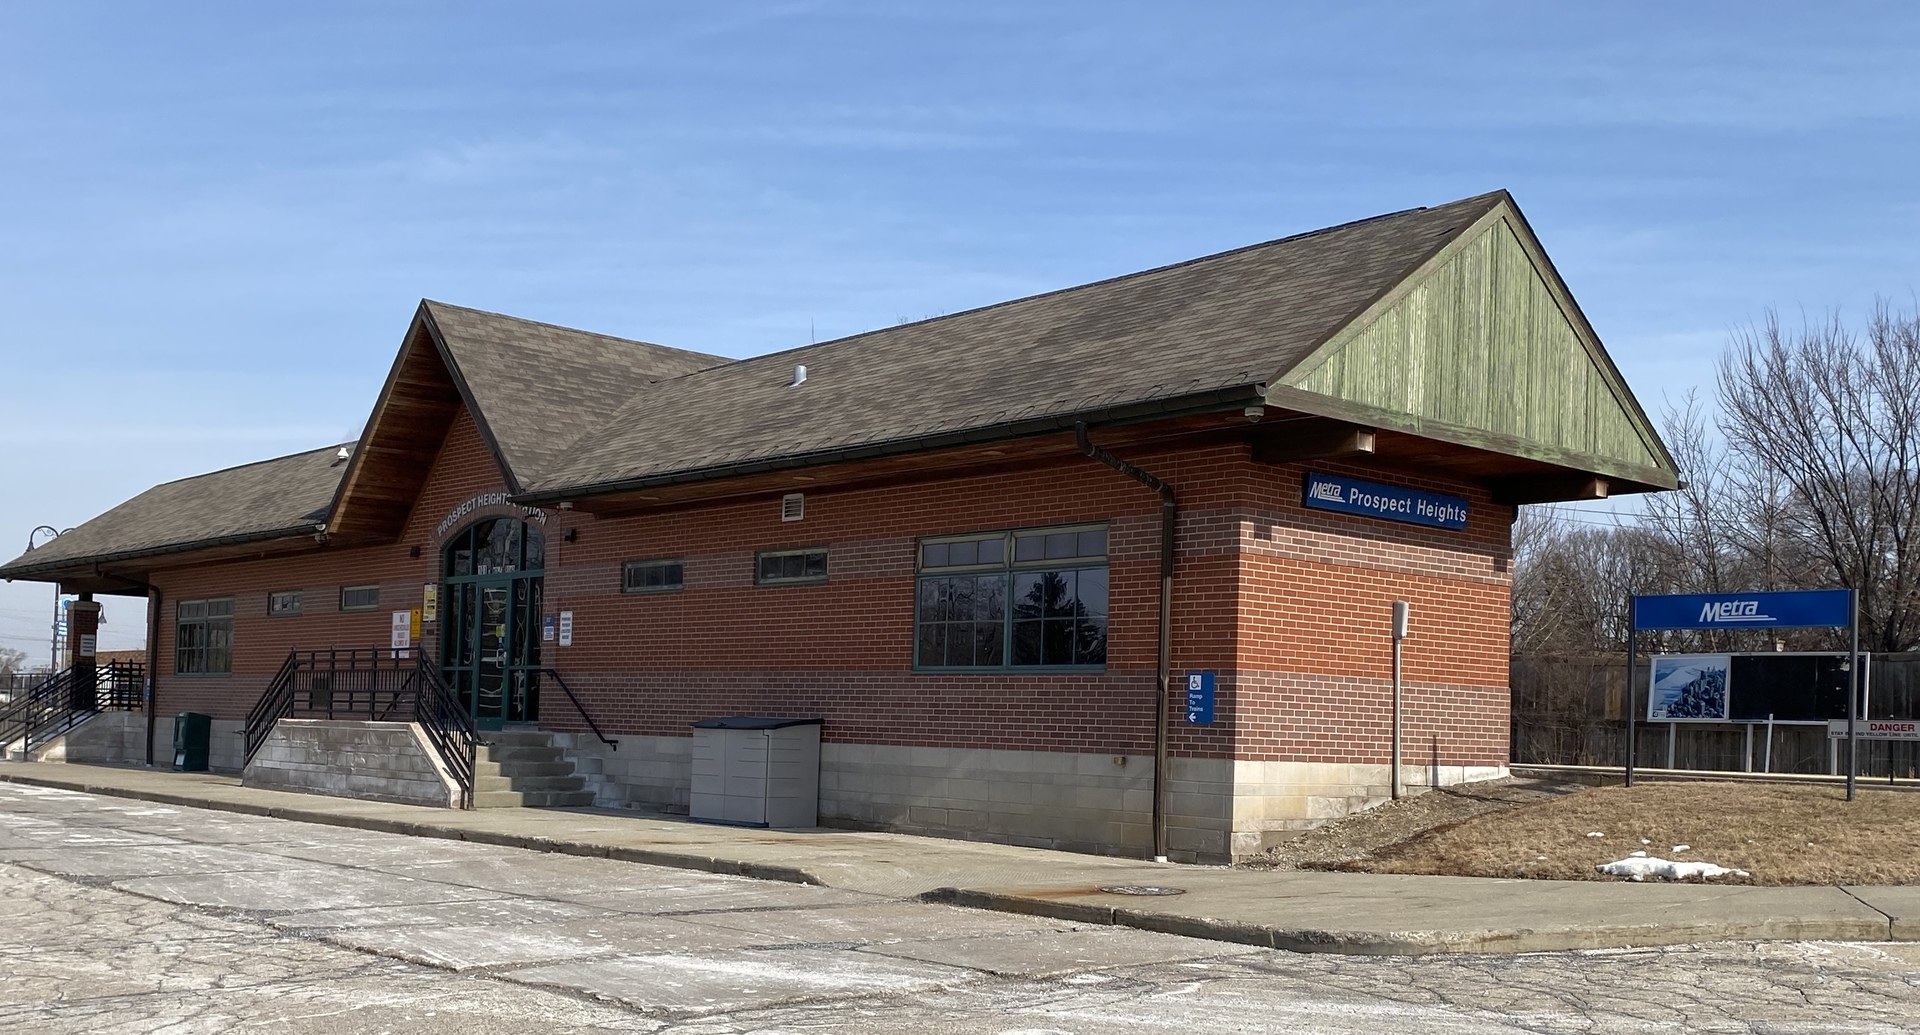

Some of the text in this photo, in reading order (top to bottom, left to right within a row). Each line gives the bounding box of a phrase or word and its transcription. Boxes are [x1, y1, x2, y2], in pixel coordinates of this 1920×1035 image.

[437, 498, 476, 536] PROSPECT
[477, 492, 512, 508] HEIGHTS
[1309, 481, 1467, 523] Metra Prospect Heights
[1699, 600, 1764, 623] Metra
[1870, 723, 1915, 732] DANGER
